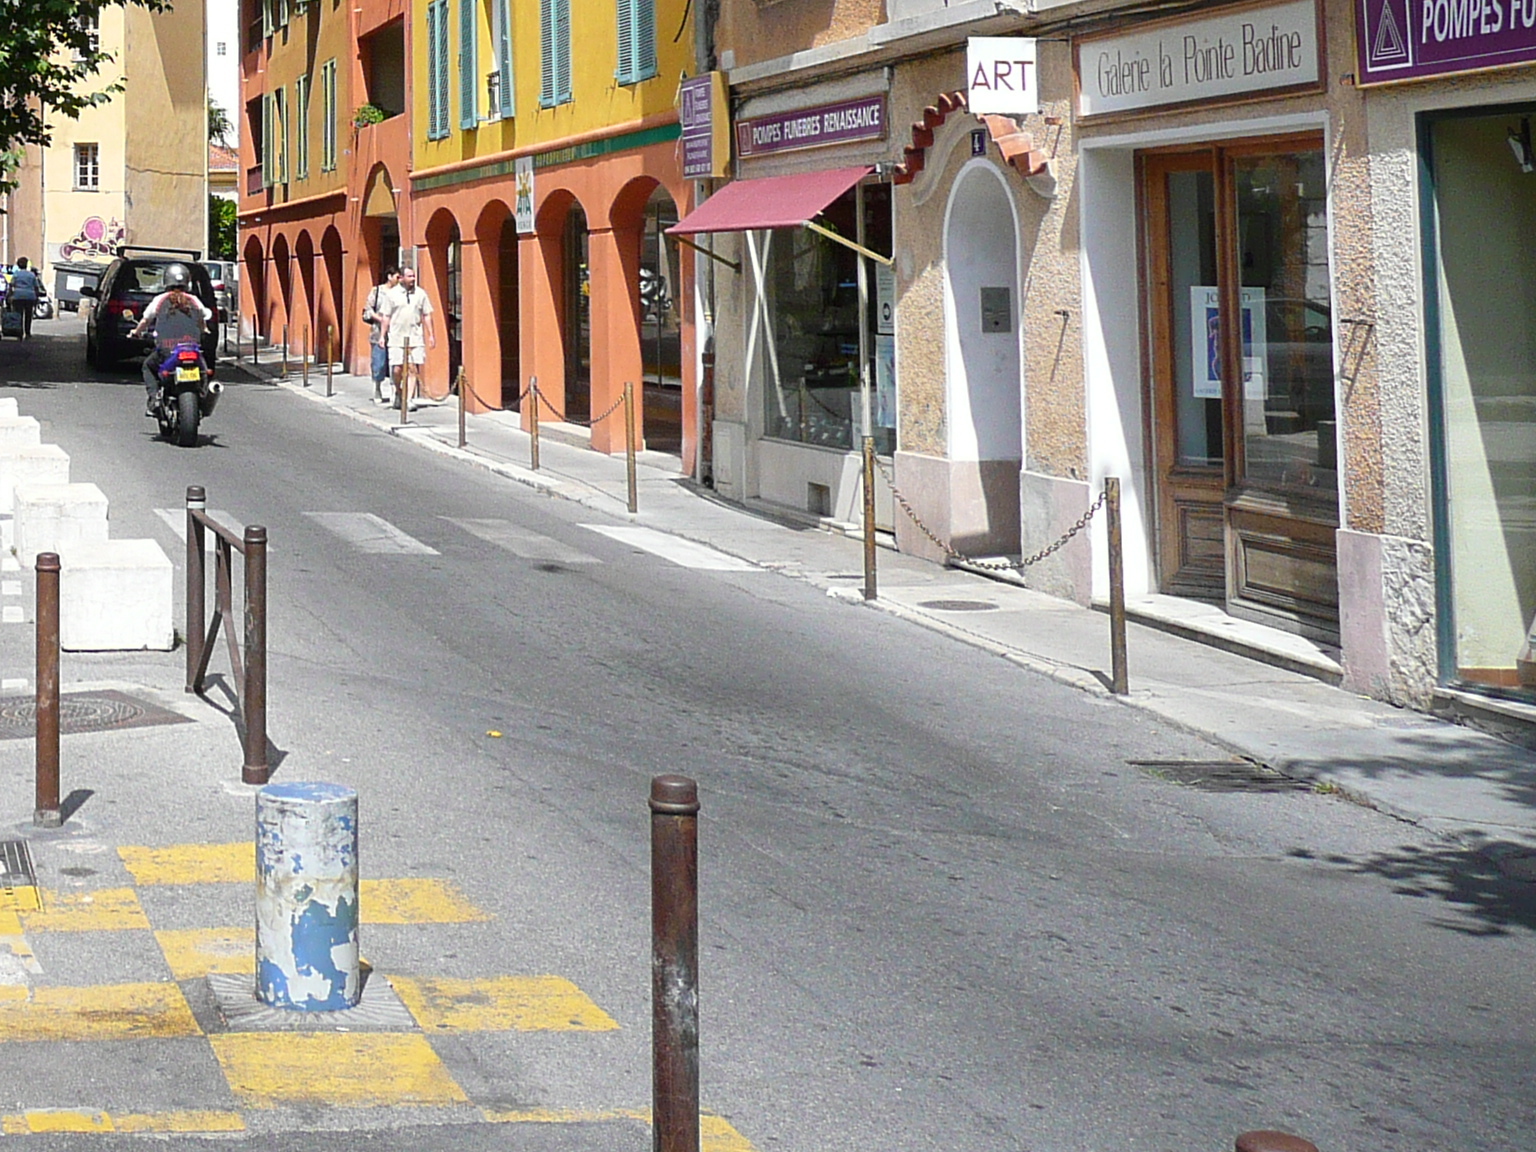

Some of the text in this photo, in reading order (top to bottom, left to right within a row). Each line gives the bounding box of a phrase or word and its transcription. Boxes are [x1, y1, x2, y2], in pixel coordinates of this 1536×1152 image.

[970, 60, 1034, 92] ART
[1097, 23, 1302, 98] Galerie la Pointe Badine
[752, 104, 881, 145] POMPES FUNEBRES RENAISSANCE
